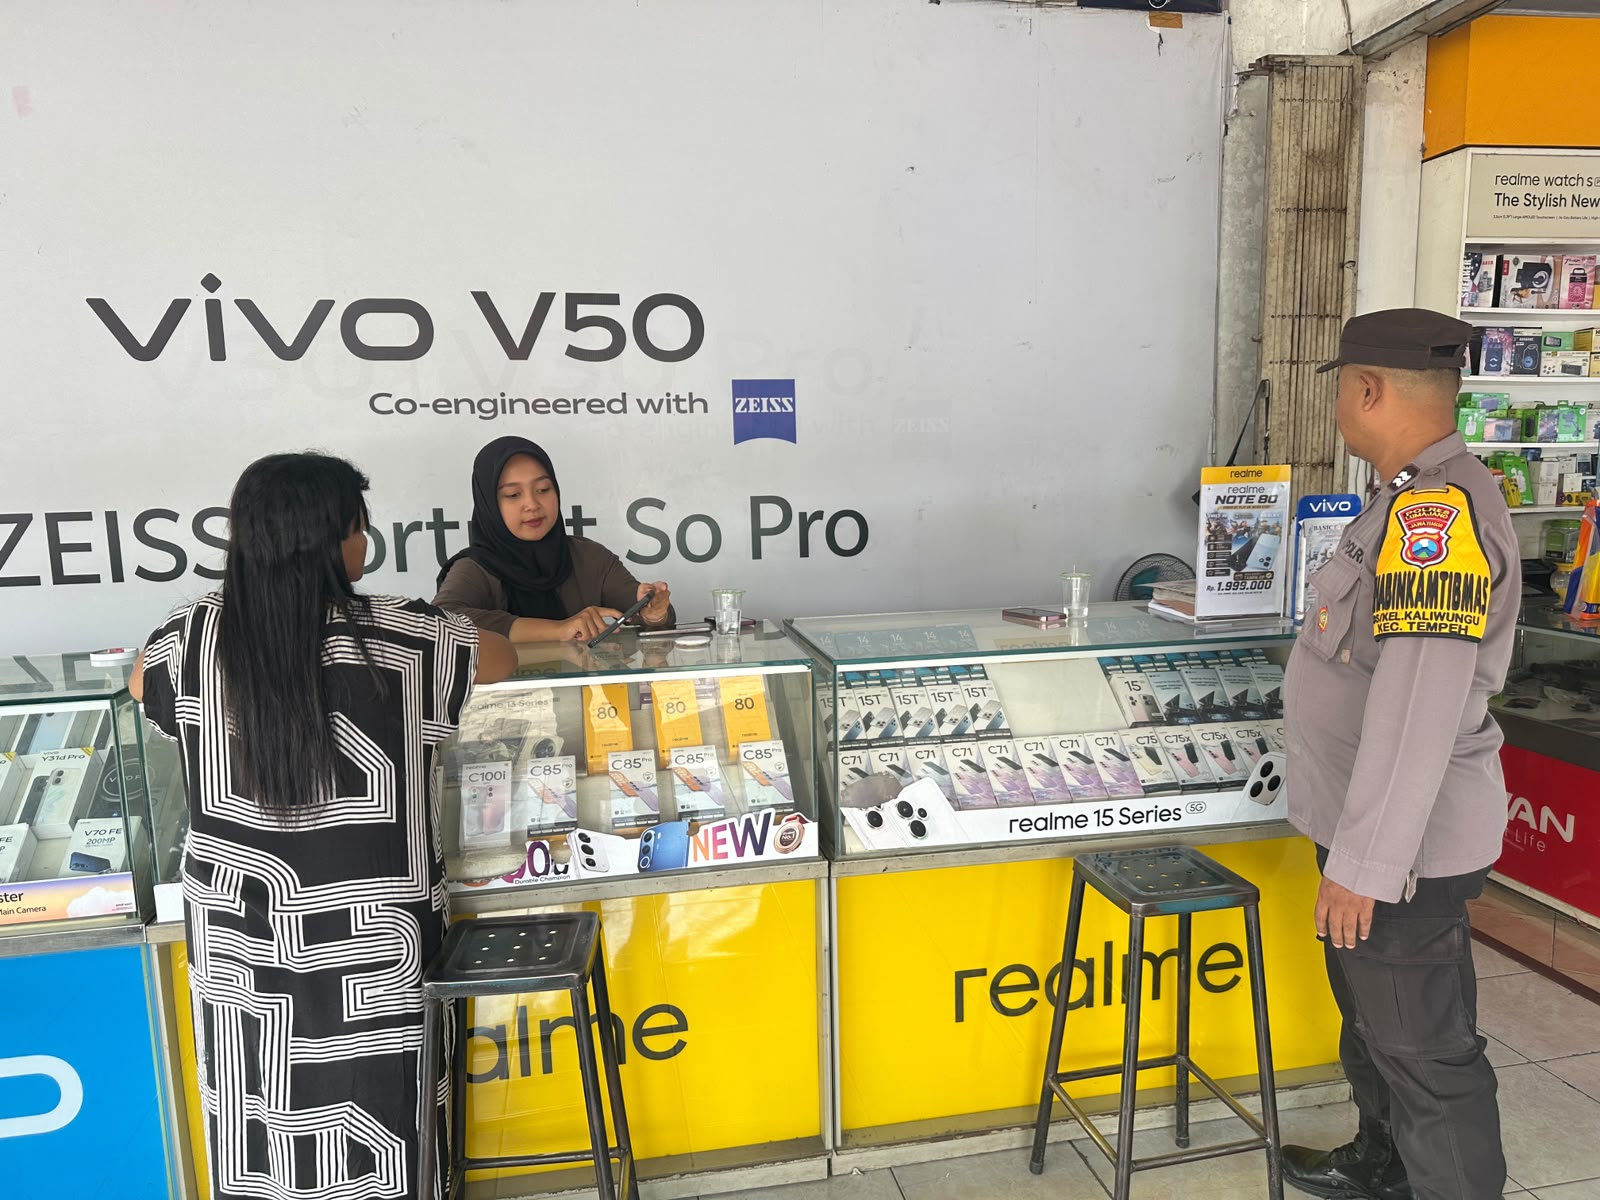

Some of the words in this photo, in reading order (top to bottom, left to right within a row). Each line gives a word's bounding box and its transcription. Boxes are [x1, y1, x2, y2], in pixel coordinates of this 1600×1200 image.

[1495, 173, 1540, 186] realme
[1544, 173, 1584, 187] watch
[1494, 192, 1520, 207] The
[1523, 192, 1567, 210] Stylish
[86, 273, 434, 361] vivo
[470, 290, 705, 362] V50
[369, 392, 627, 420] Co-engineered
[638, 392, 708, 415] with
[735, 397, 794, 413] ZEISS
[1230, 469, 1262, 478] realme
[1228, 485, 1265, 494] realme
[1215, 495, 1256, 505] NOTE
[1257, 494, 1278, 504] 80
[1309, 499, 1351, 512] vivo
[1405, 507, 1450, 517] POLRES
[0, 506, 230, 587] ZEISS
[625, 497, 722, 565] So
[750, 495, 869, 560] Pro
[1217, 580, 1272, 592] 1.999.000
[1373, 570, 1489, 616] HABINKAMTIBMAS
[1377, 622, 1403, 633] KEC.
[1407, 622, 1468, 636] TEMPEH
[1125, 680, 1142, 692] 15
[931, 691, 954, 703] 15T
[964, 687, 987, 698] 15T
[518, 698, 549, 707] Series
[734, 697, 754, 711] 80
[858, 694, 882, 706] 15T
[896, 694, 919, 705] 15T
[597, 706, 618, 719] 80
[666, 701, 686, 714] 80
[1164, 734, 1192, 744] C75x
[1201, 731, 1228, 741] C75x
[1236, 729, 1263, 739] C75x
[1024, 742, 1045, 751] C71
[1059, 739, 1080, 749] C71
[1095, 737, 1116, 746] C71
[743, 748, 773, 760] C85
[915, 750, 936, 760] C71
[951, 747, 973, 757] C71
[988, 745, 1009, 754] C71
[674, 753, 704, 765] C85
[841, 756, 863, 765] C71
[878, 752, 900, 762] C71
[530, 764, 561, 776] C85
[611, 758, 642, 770] C85
[469, 771, 506, 782] C100i
[1009, 812, 1089, 833] realme
[1094, 808, 1114, 827] 15
[1119, 805, 1182, 825] Series
[1189, 803, 1204, 812] 5G
[85, 828, 107, 836] V70
[693, 812, 772, 862] NEW
[86, 837, 116, 845] 200MP
[1516, 829, 1546, 852] Life
[0, 892, 24, 903] ster
[16, 905, 47, 914] Camera
[954, 940, 1244, 1023] realme
[467, 1004, 689, 1084] alme
